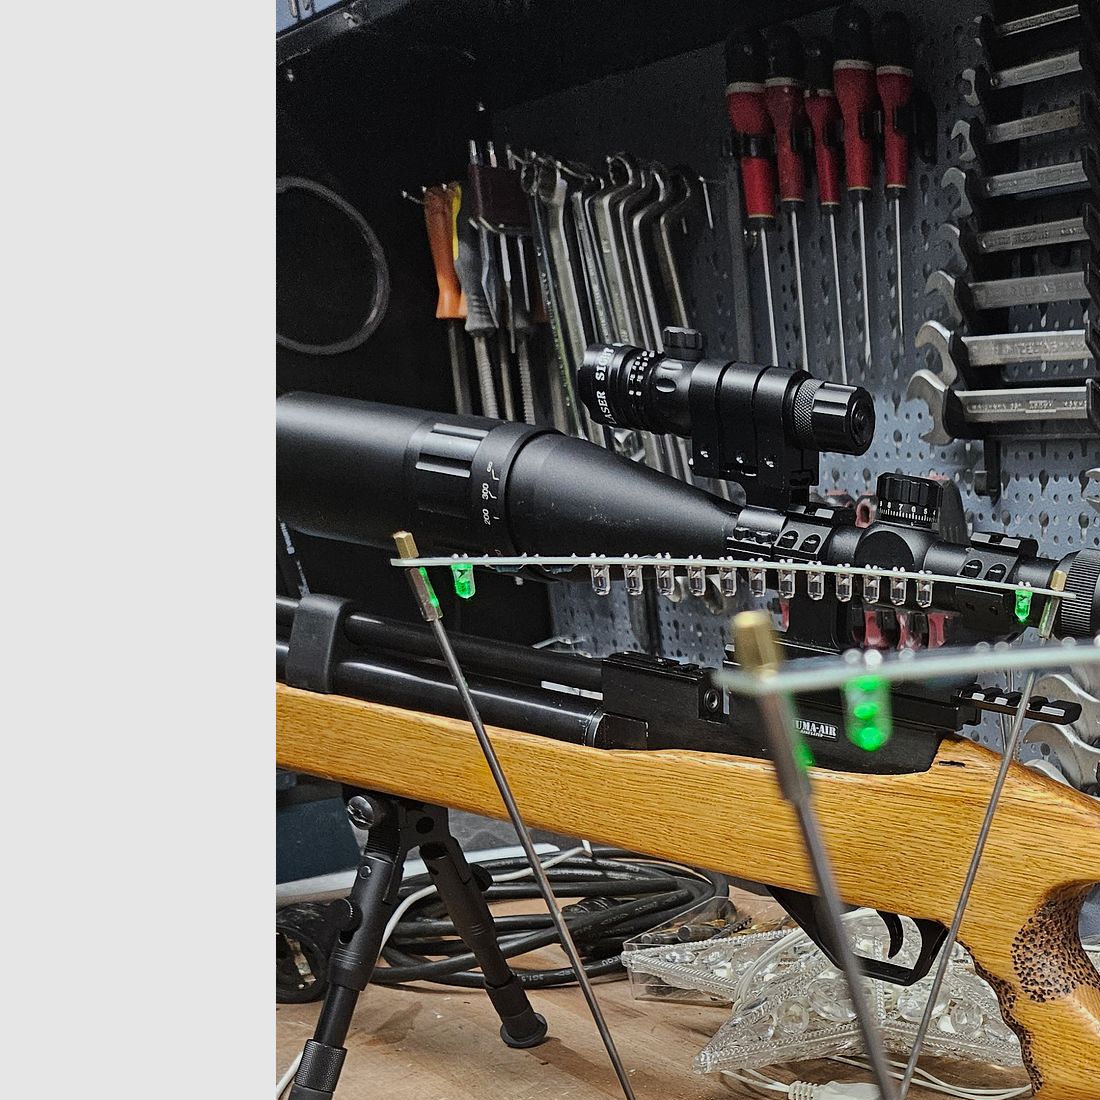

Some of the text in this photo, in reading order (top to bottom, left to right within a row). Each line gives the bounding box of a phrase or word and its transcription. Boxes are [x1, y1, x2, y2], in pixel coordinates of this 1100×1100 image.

[596, 390, 617, 425] LASER
[482, 508, 491, 526] 200
[795, 719, 837, 737] UMA-AIR
